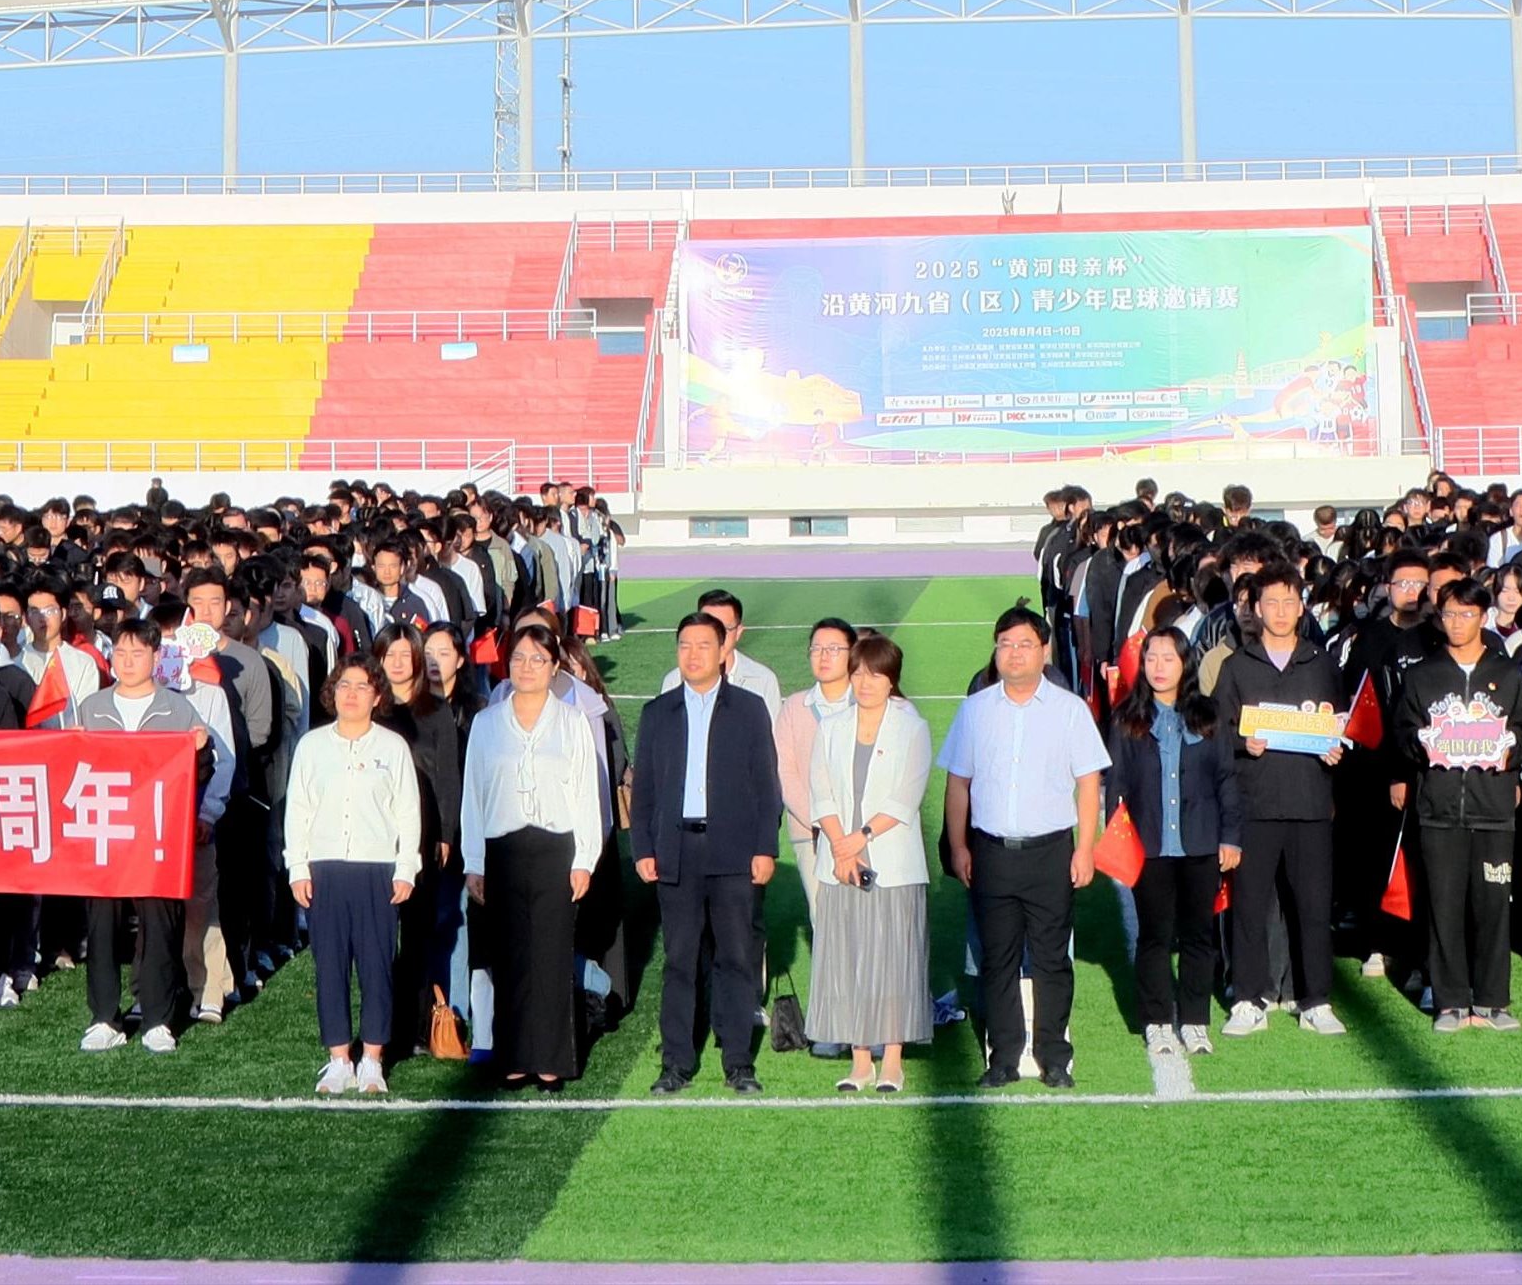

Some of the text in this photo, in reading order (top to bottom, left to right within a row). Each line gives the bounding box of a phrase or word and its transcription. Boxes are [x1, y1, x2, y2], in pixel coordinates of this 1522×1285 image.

[915, 255, 1145, 280] 2025 “黄河母亲杯”
[821, 286, 1240, 316] 沿黄河九省（区）青少年足球邀请赛
[1437, 739, 1494, 754] 强国有我
